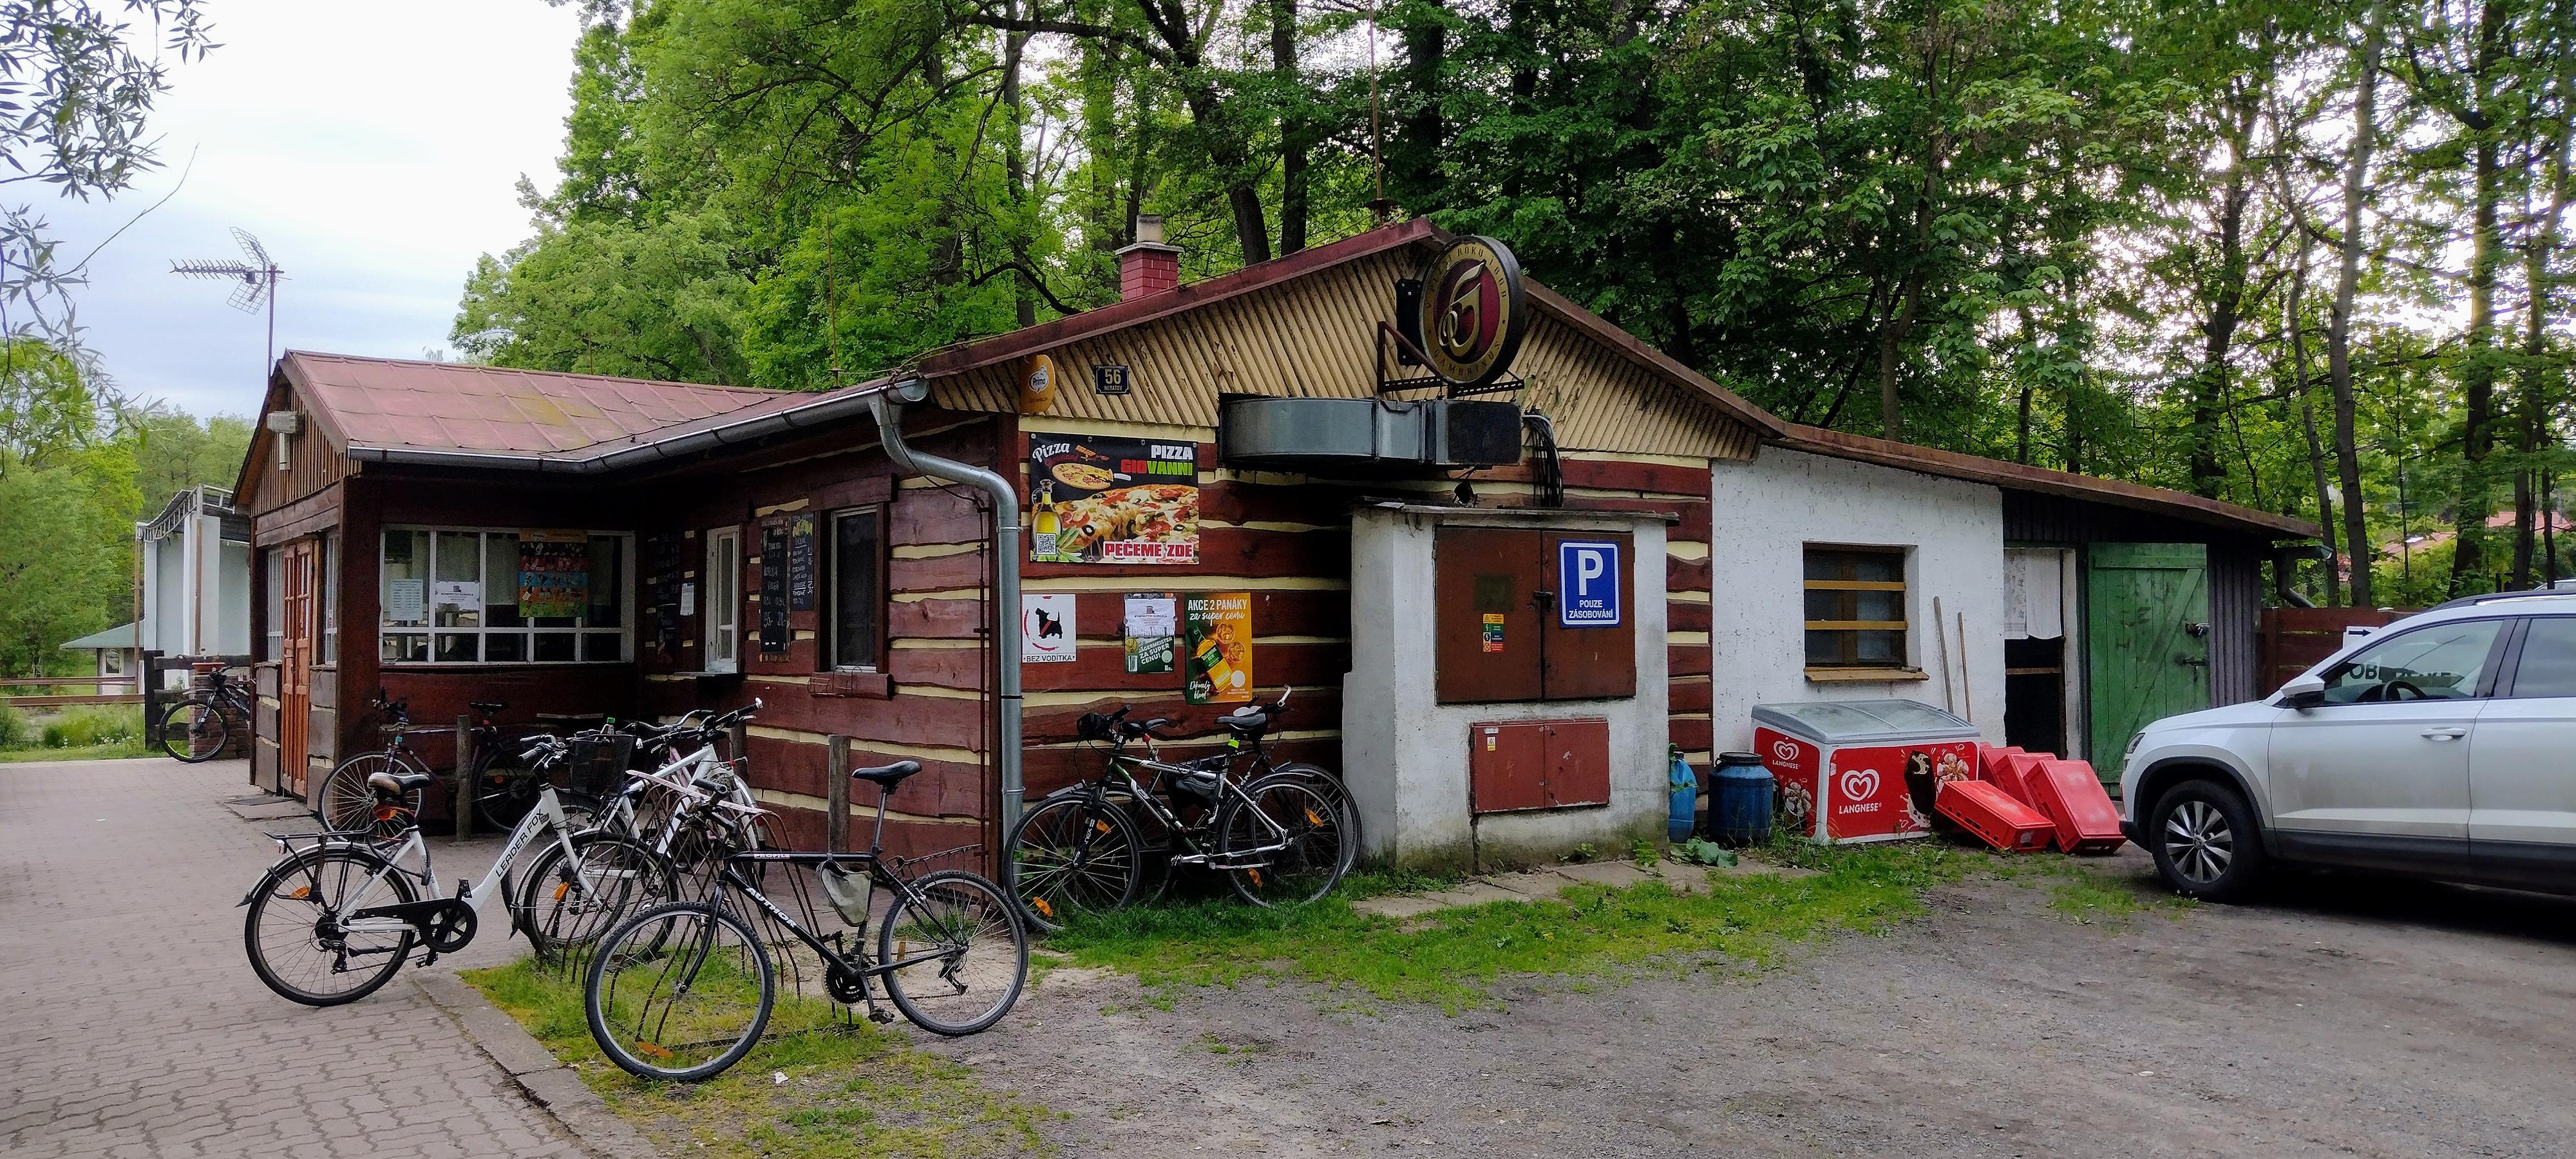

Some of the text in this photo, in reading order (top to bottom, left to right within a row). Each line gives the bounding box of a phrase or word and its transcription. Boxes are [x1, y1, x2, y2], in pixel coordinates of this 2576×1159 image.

[1457, 247, 1484, 257] ROKU
[1434, 341, 1500, 376] GAMBRINUS
[1104, 368, 1121, 384] 56
[1032, 443, 1070, 463] Pizza
[1151, 445, 1193, 460] PIZZA
[1121, 459, 1193, 475] GIOVANNI
[1104, 540, 1192, 557] PEČEME ZDE
[1578, 550, 1604, 596] P
[1188, 597, 1247, 610] AKCE 2 PANÁKY
[1202, 612, 1225, 627] super
[1226, 611, 1245, 620] cenu
[1568, 608, 1613, 618] ZÁSOBOVÁNÍ
[1139, 636, 1172, 654] JÄGERMEISTER
[1149, 643, 1170, 655] SUPER
[1772, 759, 1799, 769] LANGNESE
[1839, 803, 1879, 815] LANGNESE
[496, 808, 544, 878] LEADER FOX
[745, 887, 797, 928] AUTHOR
